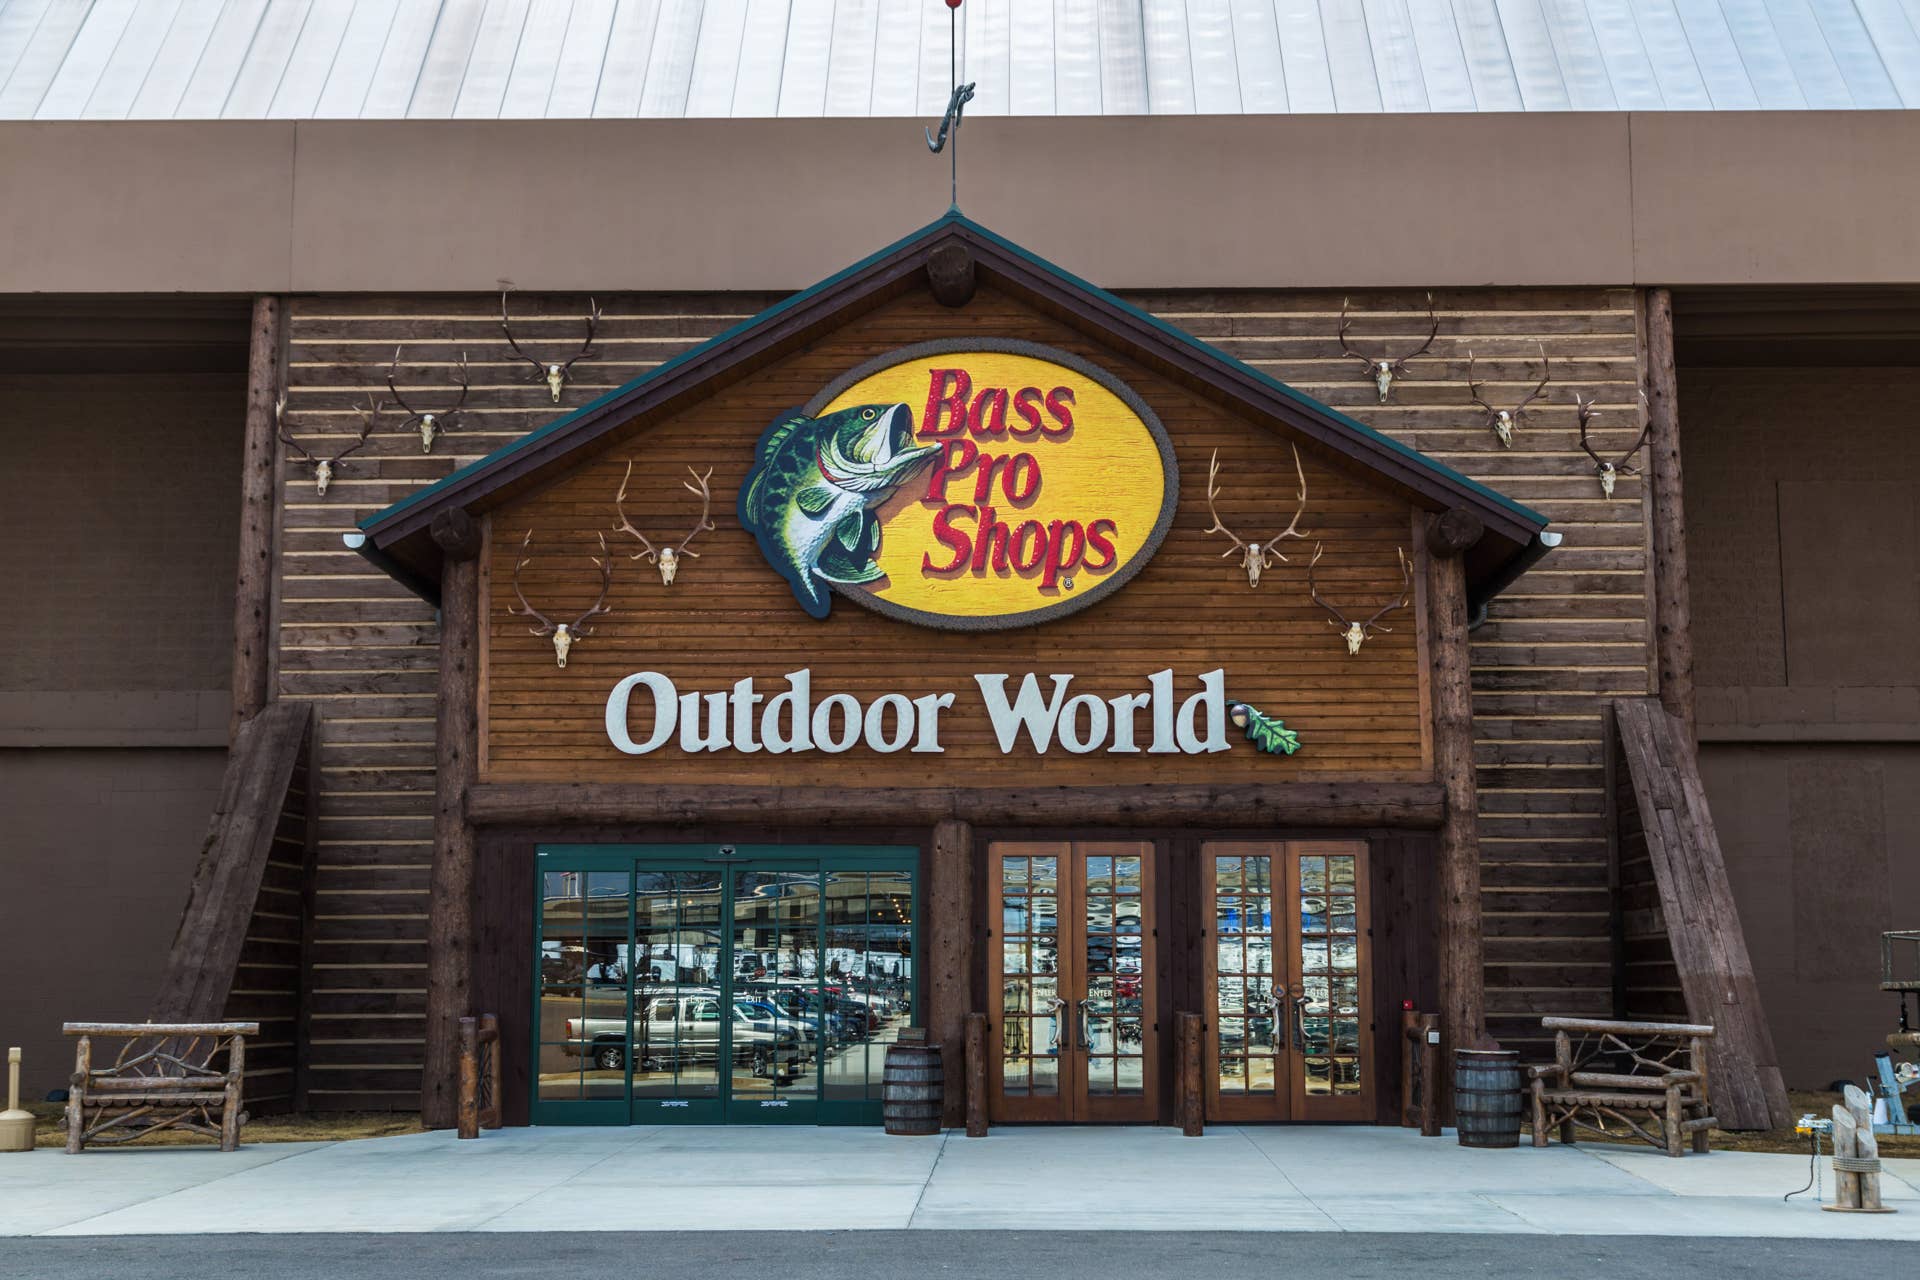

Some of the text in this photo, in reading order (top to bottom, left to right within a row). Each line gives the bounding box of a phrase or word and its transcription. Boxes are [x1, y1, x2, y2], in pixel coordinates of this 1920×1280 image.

[916, 368, 1075, 438] Bass
[920, 438, 1041, 506] Pro
[921, 504, 1117, 592] Shops
[604, 668, 1232, 755] Outdoor World
[745, 995, 762, 1003] EXIT
[1033, 988, 1057, 997] ENTER
[1088, 988, 1113, 997] ENTER
